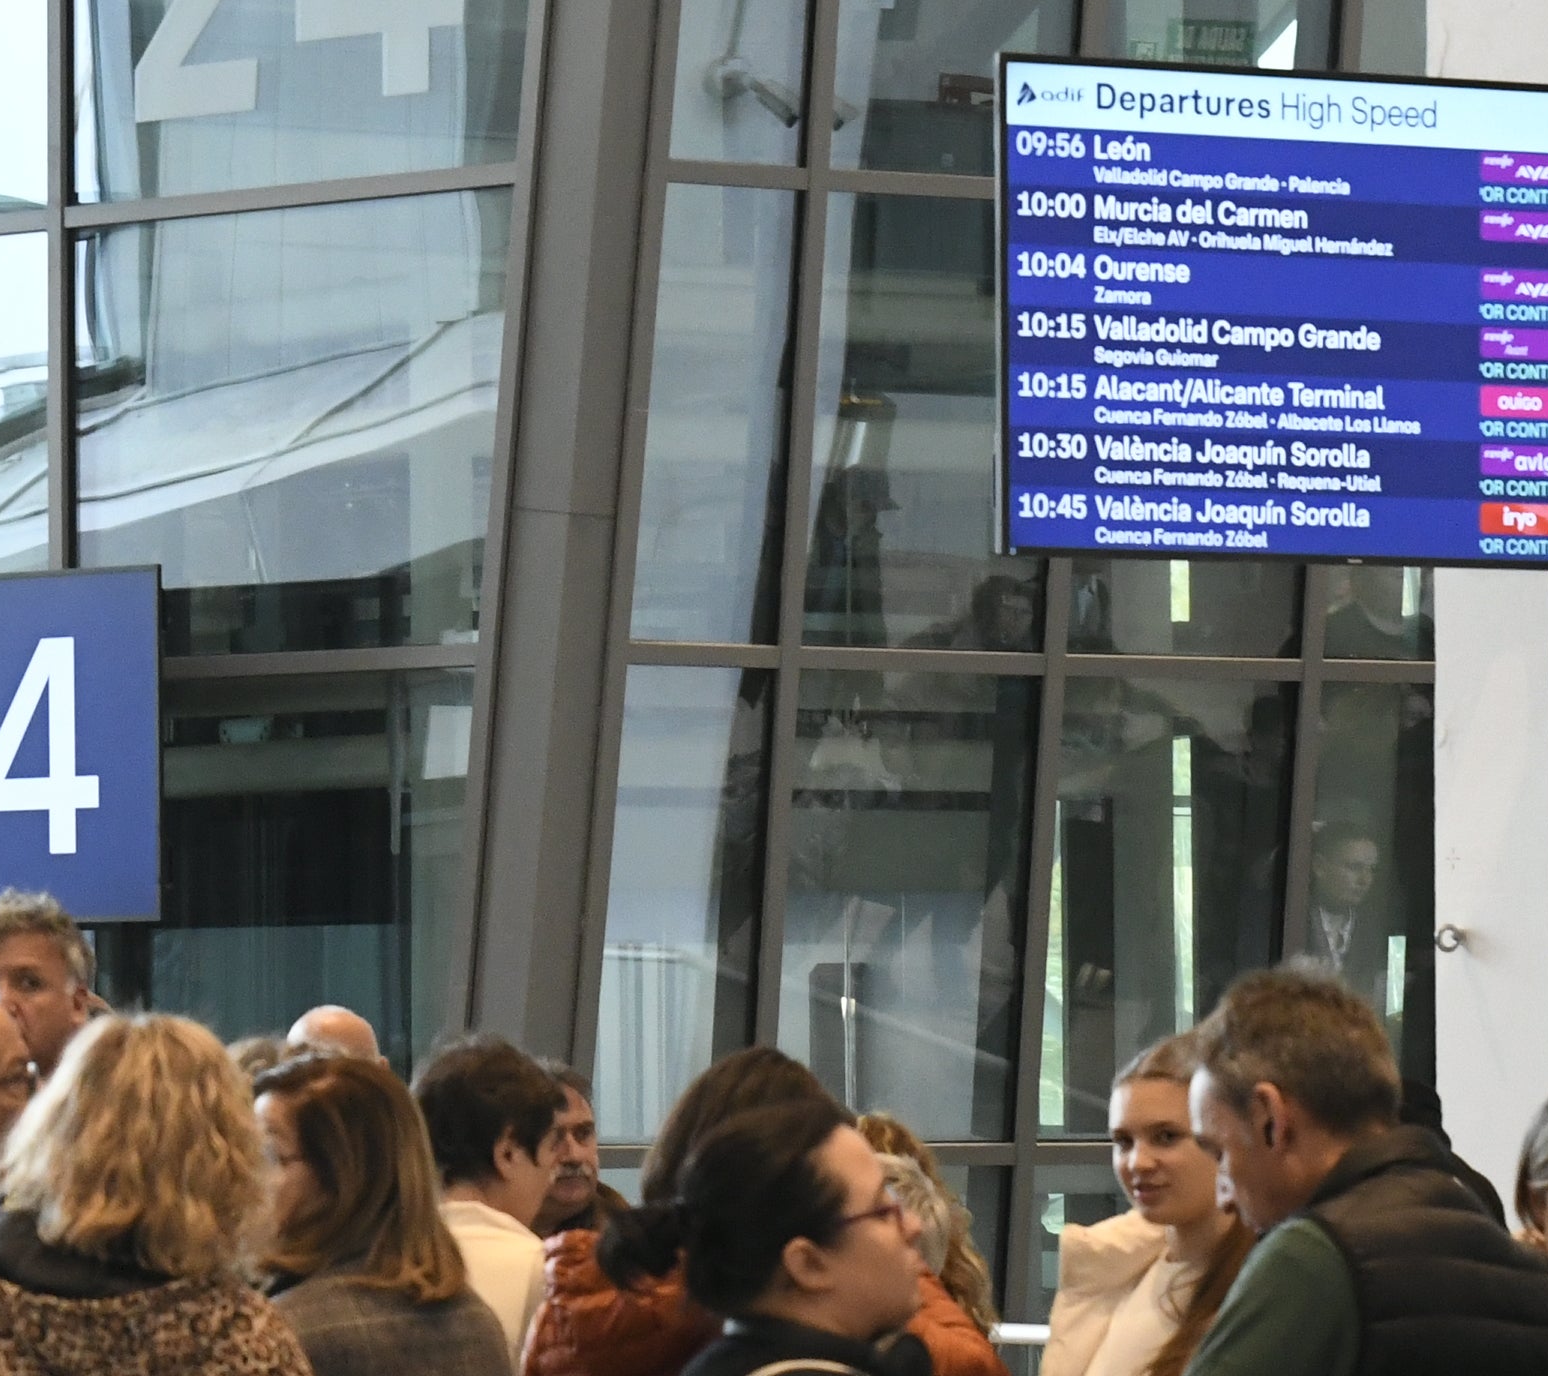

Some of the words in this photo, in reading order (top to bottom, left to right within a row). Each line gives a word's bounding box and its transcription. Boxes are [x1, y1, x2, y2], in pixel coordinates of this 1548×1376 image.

[1040, 86, 1085, 102] adif
[1096, 82, 1271, 120] Departures
[1280, 91, 1342, 130] High
[1351, 95, 1438, 132] Speed
[1015, 130, 1086, 158] 09:56
[1093, 134, 1151, 162] León
[1093, 166, 1167, 186] Valladolid
[1168, 169, 1223, 192] Campo
[1224, 172, 1280, 192] Grande
[1288, 175, 1351, 195] Palencia
[1479, 186, 1504, 203] OR
[1016, 191, 1087, 218] 10:00
[1093, 194, 1173, 222] Murcia
[1176, 198, 1215, 225] del
[1217, 201, 1309, 229] Carmen
[1167, 229, 1190, 247] AV
[1263, 233, 1313, 255] Miguel
[1016, 251, 1087, 279] 10:04
[1093, 254, 1191, 283] Ourense
[1093, 285, 1152, 305] Zamora
[1479, 304, 1504, 321] OR
[1017, 311, 1087, 339] 10:15
[1093, 314, 1208, 344] Valladolid
[1211, 319, 1295, 352] Campo
[1298, 322, 1382, 351] Grande
[1093, 345, 1154, 368] Segovia
[1155, 348, 1219, 368] Guiomar
[1479, 362, 1504, 379] OR
[1017, 371, 1087, 399] 10:15
[1093, 375, 1285, 408] Alacant/Alicante
[1287, 382, 1386, 410] Terminal
[1093, 405, 1152, 425] Cuenca
[1153, 408, 1224, 428] Fernando
[1225, 410, 1268, 429] Zóbel
[1344, 415, 1372, 433] Los
[1479, 420, 1504, 438] OR
[1017, 432, 1088, 460] 10:30
[1093, 434, 1192, 463] València
[1195, 438, 1287, 470] Joaquín
[1290, 441, 1371, 469] Sorolla
[1093, 466, 1152, 485] Cuenca
[1153, 468, 1224, 488] Fernando
[1225, 470, 1269, 489] Zóbel
[1479, 479, 1504, 496] OR
[1018, 492, 1088, 519] 10:45
[1093, 495, 1192, 523] València
[1195, 498, 1287, 530] Joaquín
[1290, 500, 1371, 528] Sorolla
[1502, 506, 1538, 532] iryo
[1094, 526, 1152, 545] Cuenca
[1153, 528, 1224, 546] Fernando
[1225, 530, 1269, 548] Zóbel
[1479, 538, 1504, 555] OR
